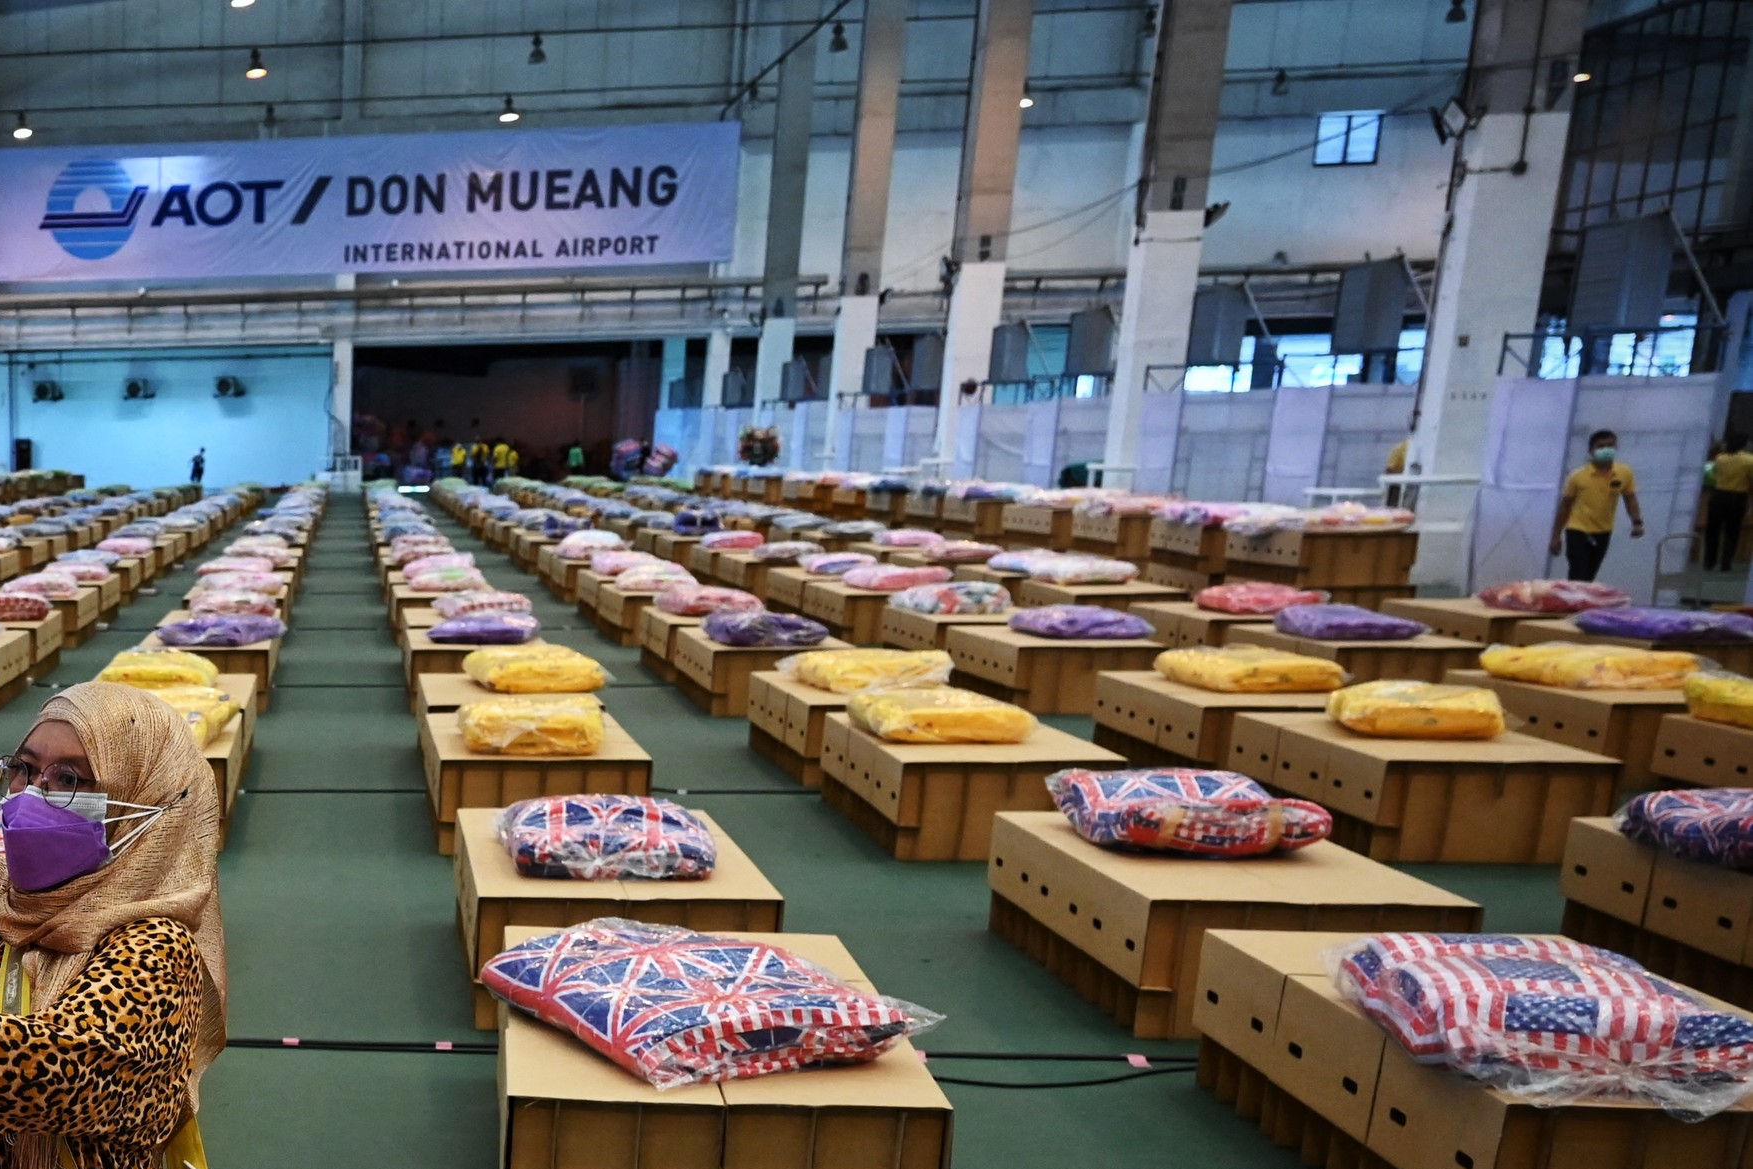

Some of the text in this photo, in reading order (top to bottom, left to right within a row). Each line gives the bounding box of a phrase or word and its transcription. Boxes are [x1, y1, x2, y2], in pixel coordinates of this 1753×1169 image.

[150, 180, 284, 227] AOT
[345, 172, 447, 217] DON
[465, 164, 679, 213] MUEANG
[344, 235, 660, 263] INTERNATIONAL AIRPORT
